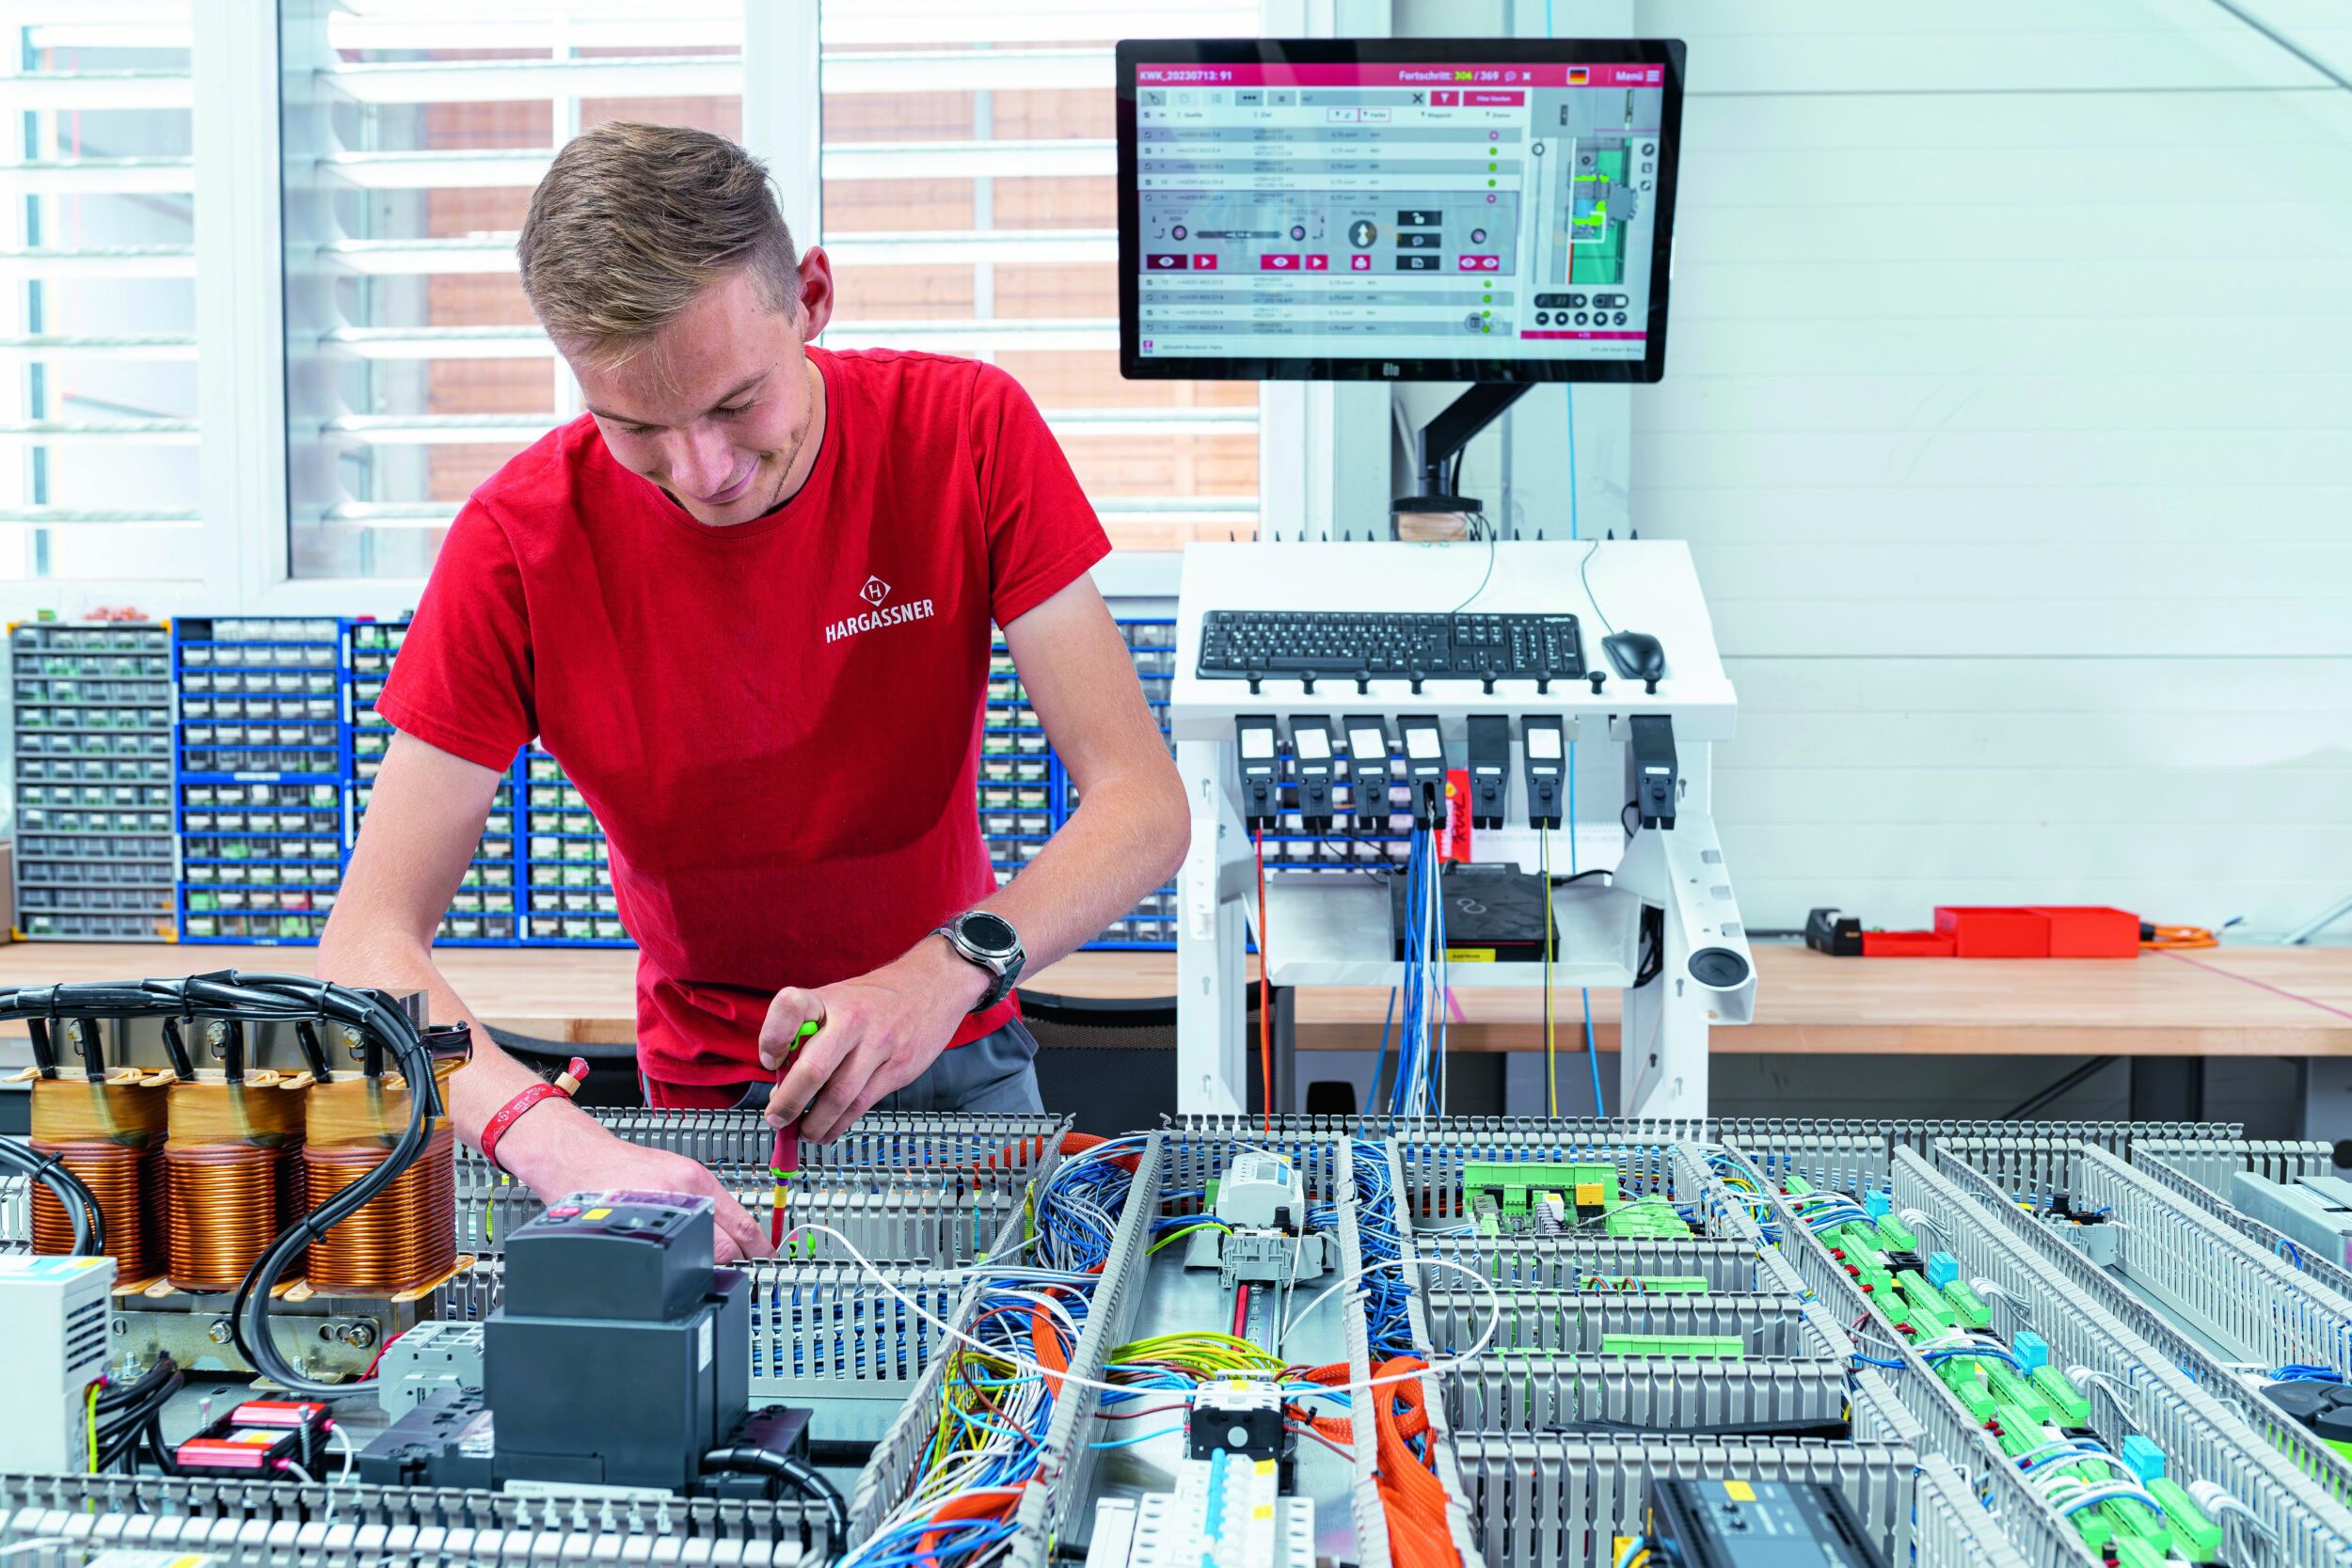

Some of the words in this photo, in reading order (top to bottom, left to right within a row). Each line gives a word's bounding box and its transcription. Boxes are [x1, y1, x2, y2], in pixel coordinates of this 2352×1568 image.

[1399, 71, 1452, 81] Fortschritt:
[1615, 71, 1644, 82] Menü
[825, 598, 934, 644] HARGASSNER
